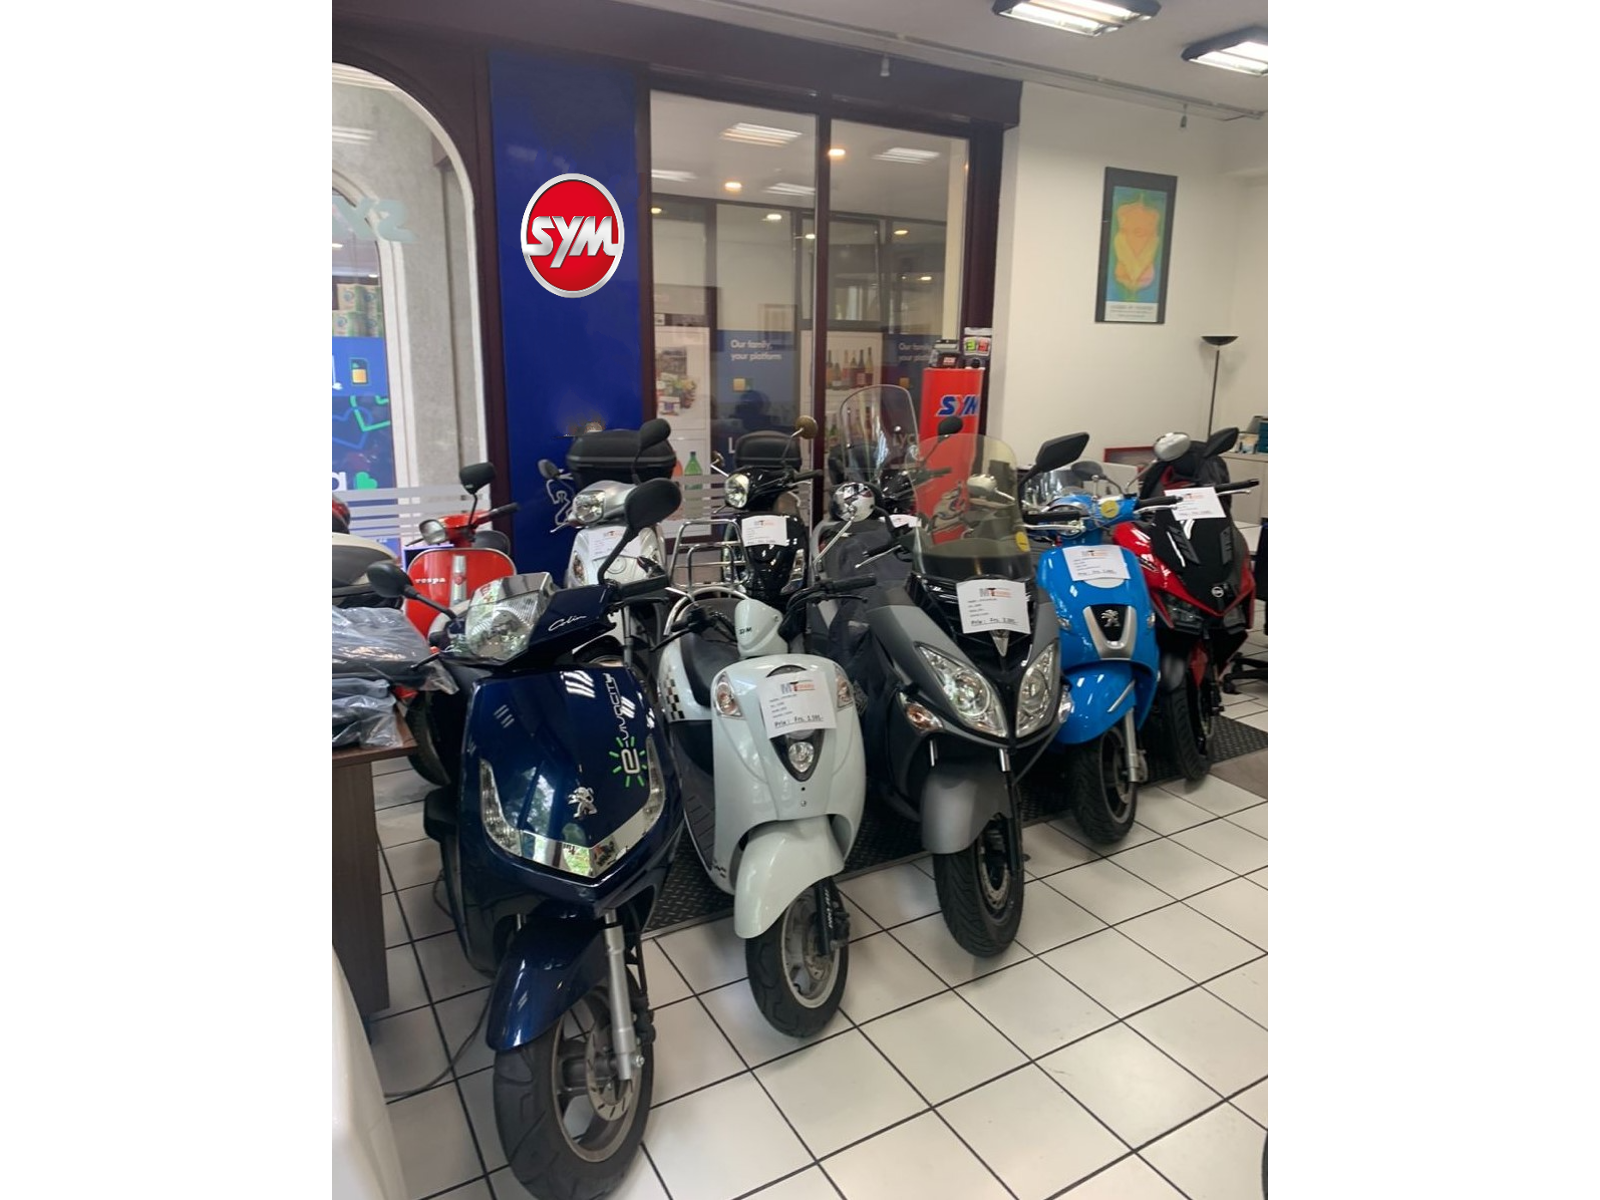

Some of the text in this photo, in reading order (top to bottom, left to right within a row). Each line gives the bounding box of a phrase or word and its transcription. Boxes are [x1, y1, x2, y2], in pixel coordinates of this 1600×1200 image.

[522, 215, 619, 269] SYM
[731, 339, 747, 348] Our
[731, 353, 748, 361] your
